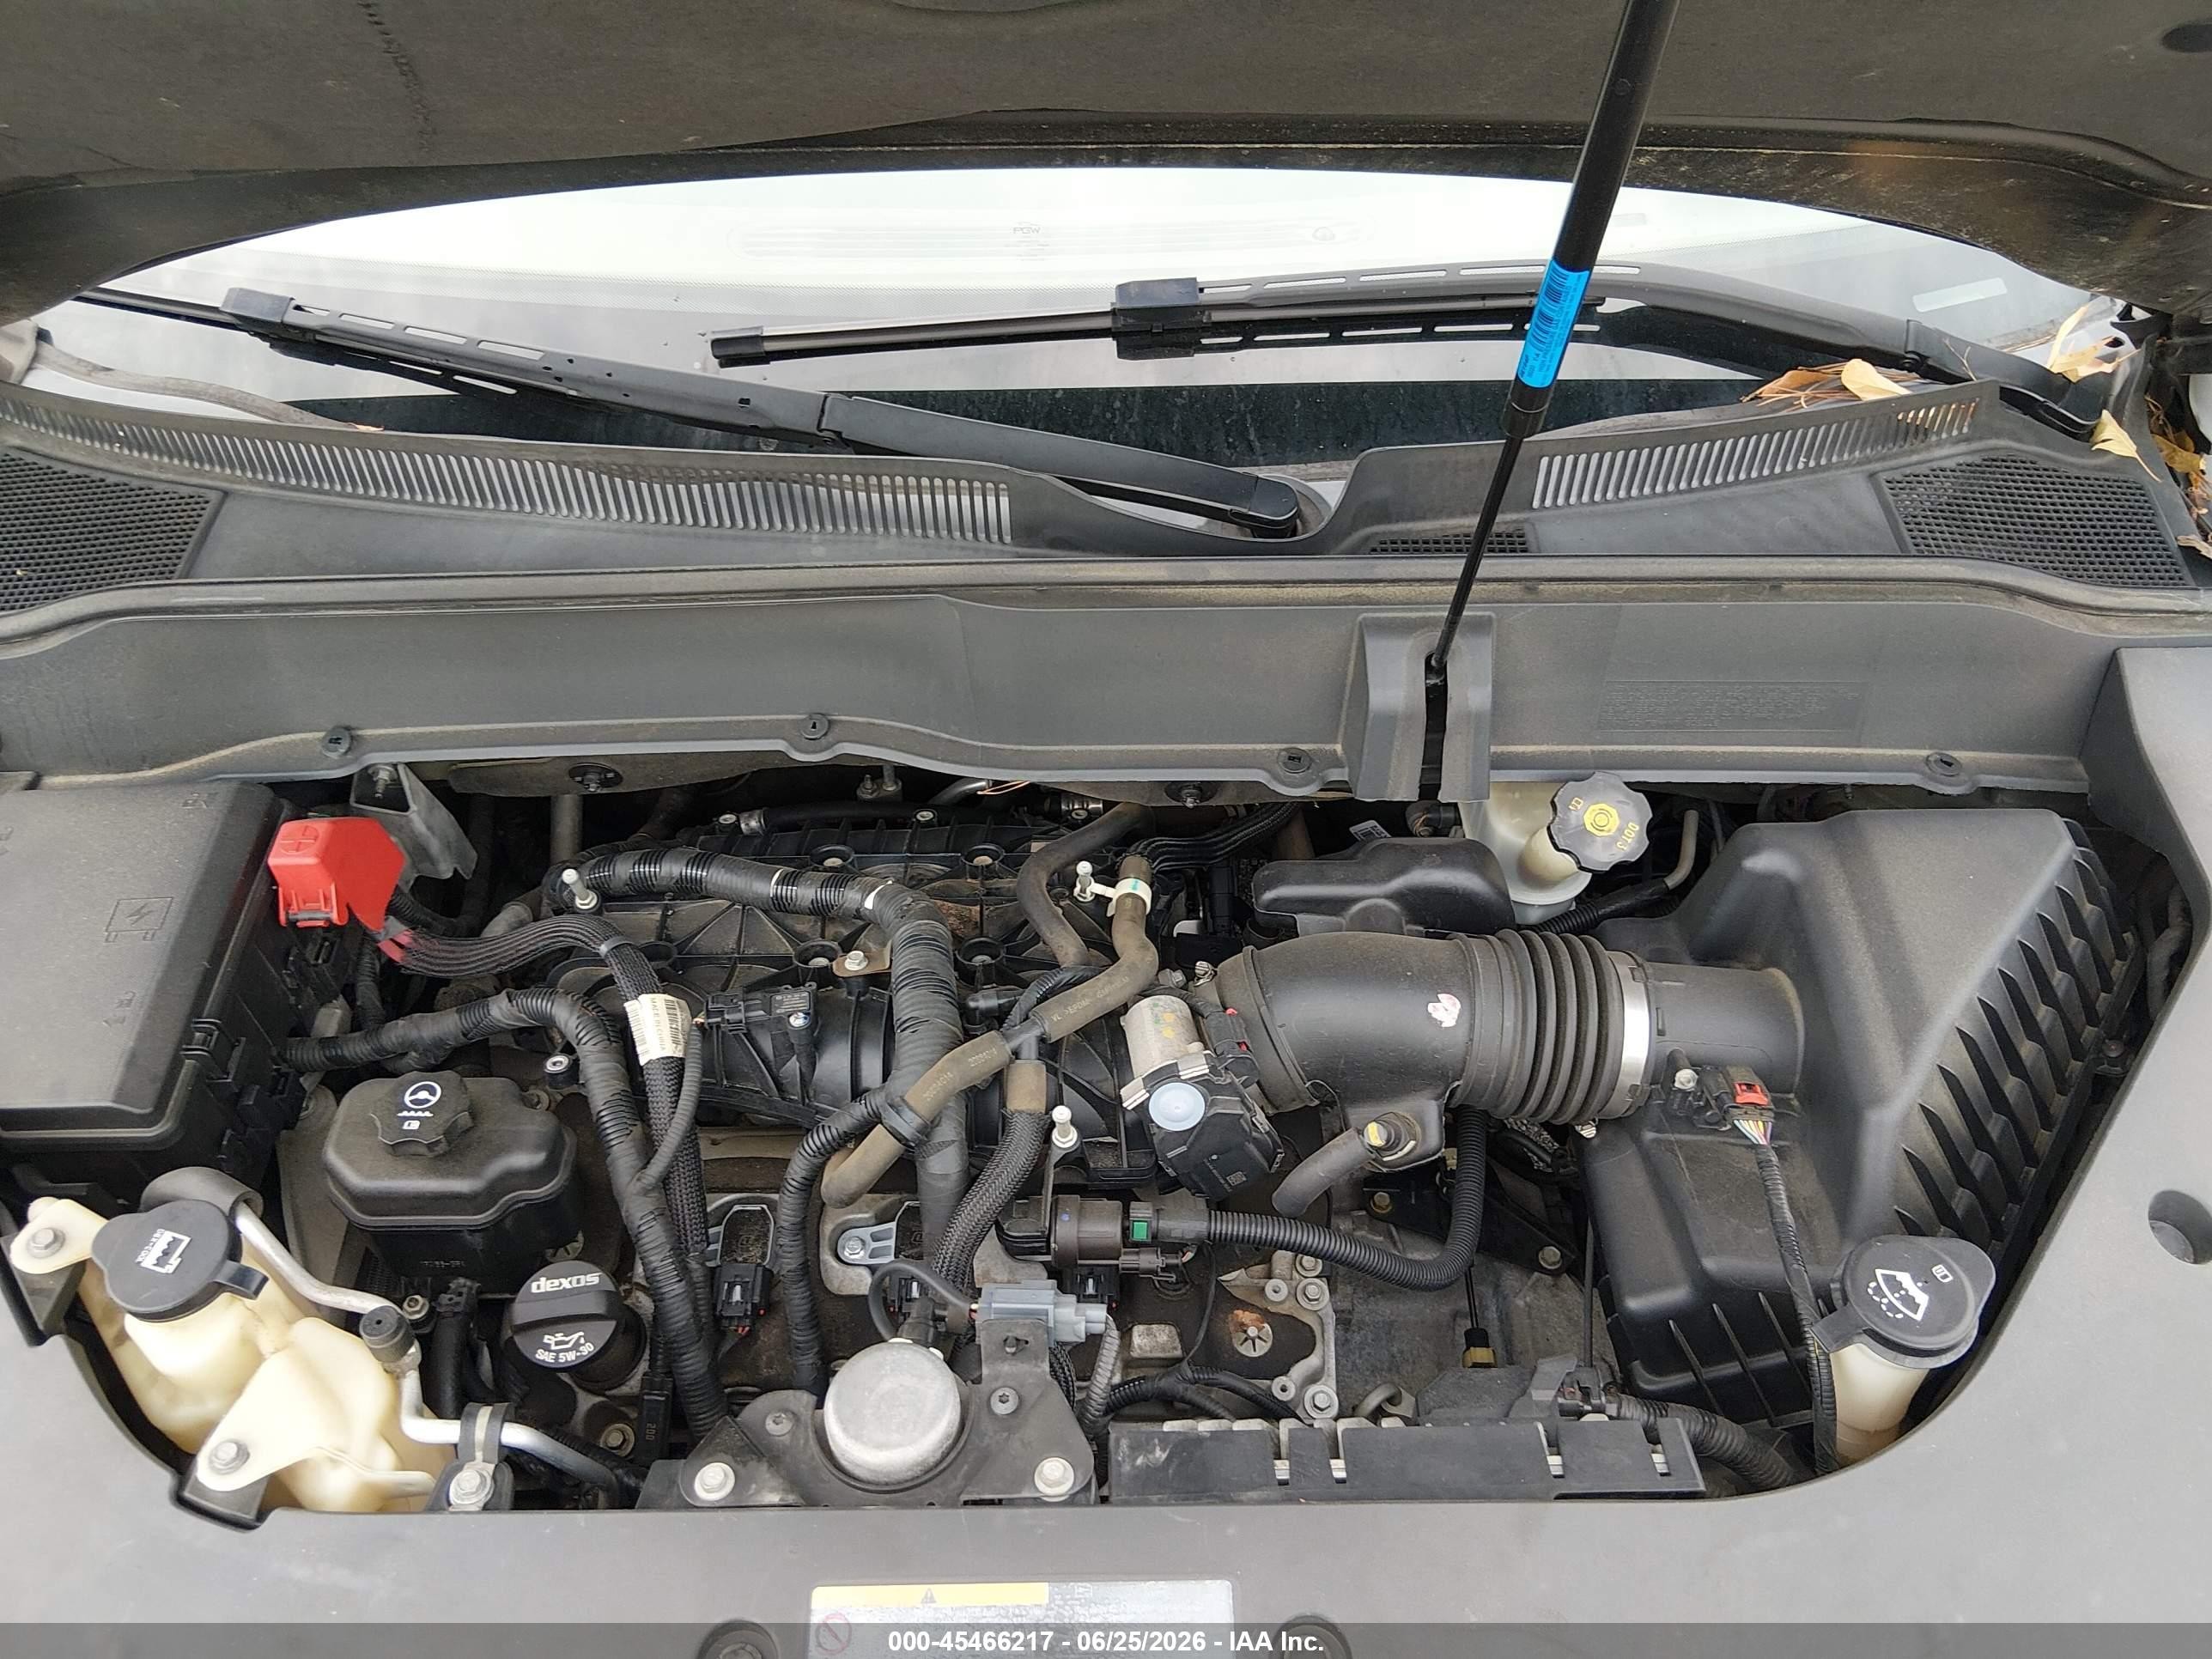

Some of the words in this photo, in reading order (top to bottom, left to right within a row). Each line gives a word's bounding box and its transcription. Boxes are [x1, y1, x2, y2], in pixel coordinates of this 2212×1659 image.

[1621, 822, 1639, 843] DOT
[1616, 841, 1627, 850] 3
[531, 1272, 603, 1293] dexos
[535, 1349, 556, 1363] SAE
[558, 1342, 595, 1363] 5W-30
